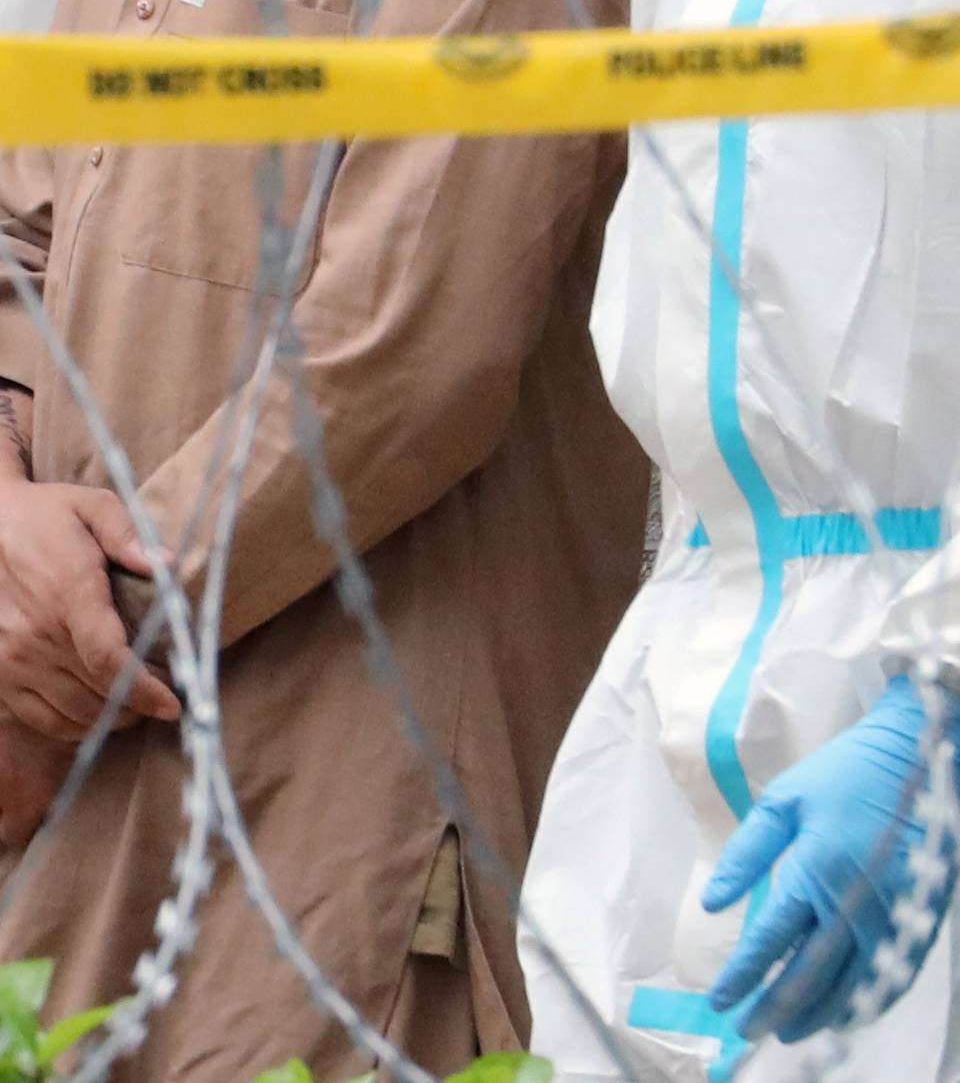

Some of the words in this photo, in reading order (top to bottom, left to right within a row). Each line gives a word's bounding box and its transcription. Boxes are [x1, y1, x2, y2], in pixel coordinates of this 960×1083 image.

[612, 42, 722, 81] POLICE
[730, 36, 807, 73] LINE
[146, 67, 205, 98] NOT
[216, 63, 323, 97] CROSS
